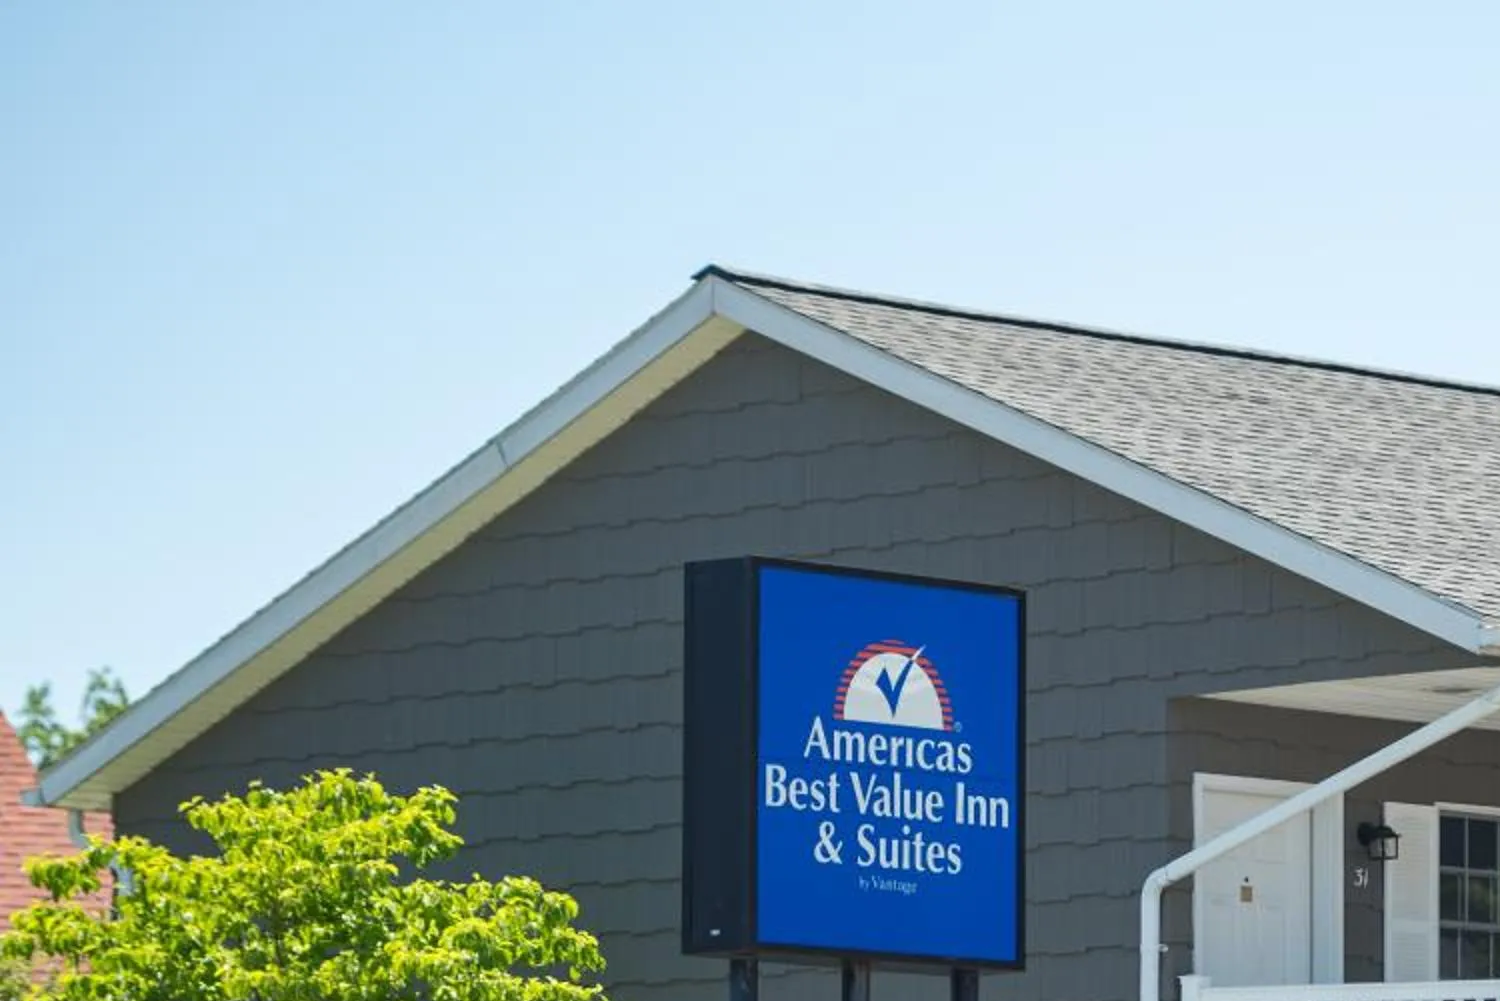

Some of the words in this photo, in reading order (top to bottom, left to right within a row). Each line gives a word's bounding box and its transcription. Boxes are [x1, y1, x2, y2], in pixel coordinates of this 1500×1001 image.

[804, 715, 973, 773] Americas
[765, 764, 840, 813] Best
[850, 772, 944, 822] Value
[955, 782, 1009, 828] Inn
[814, 821, 843, 863] &
[857, 824, 961, 874] Suites
